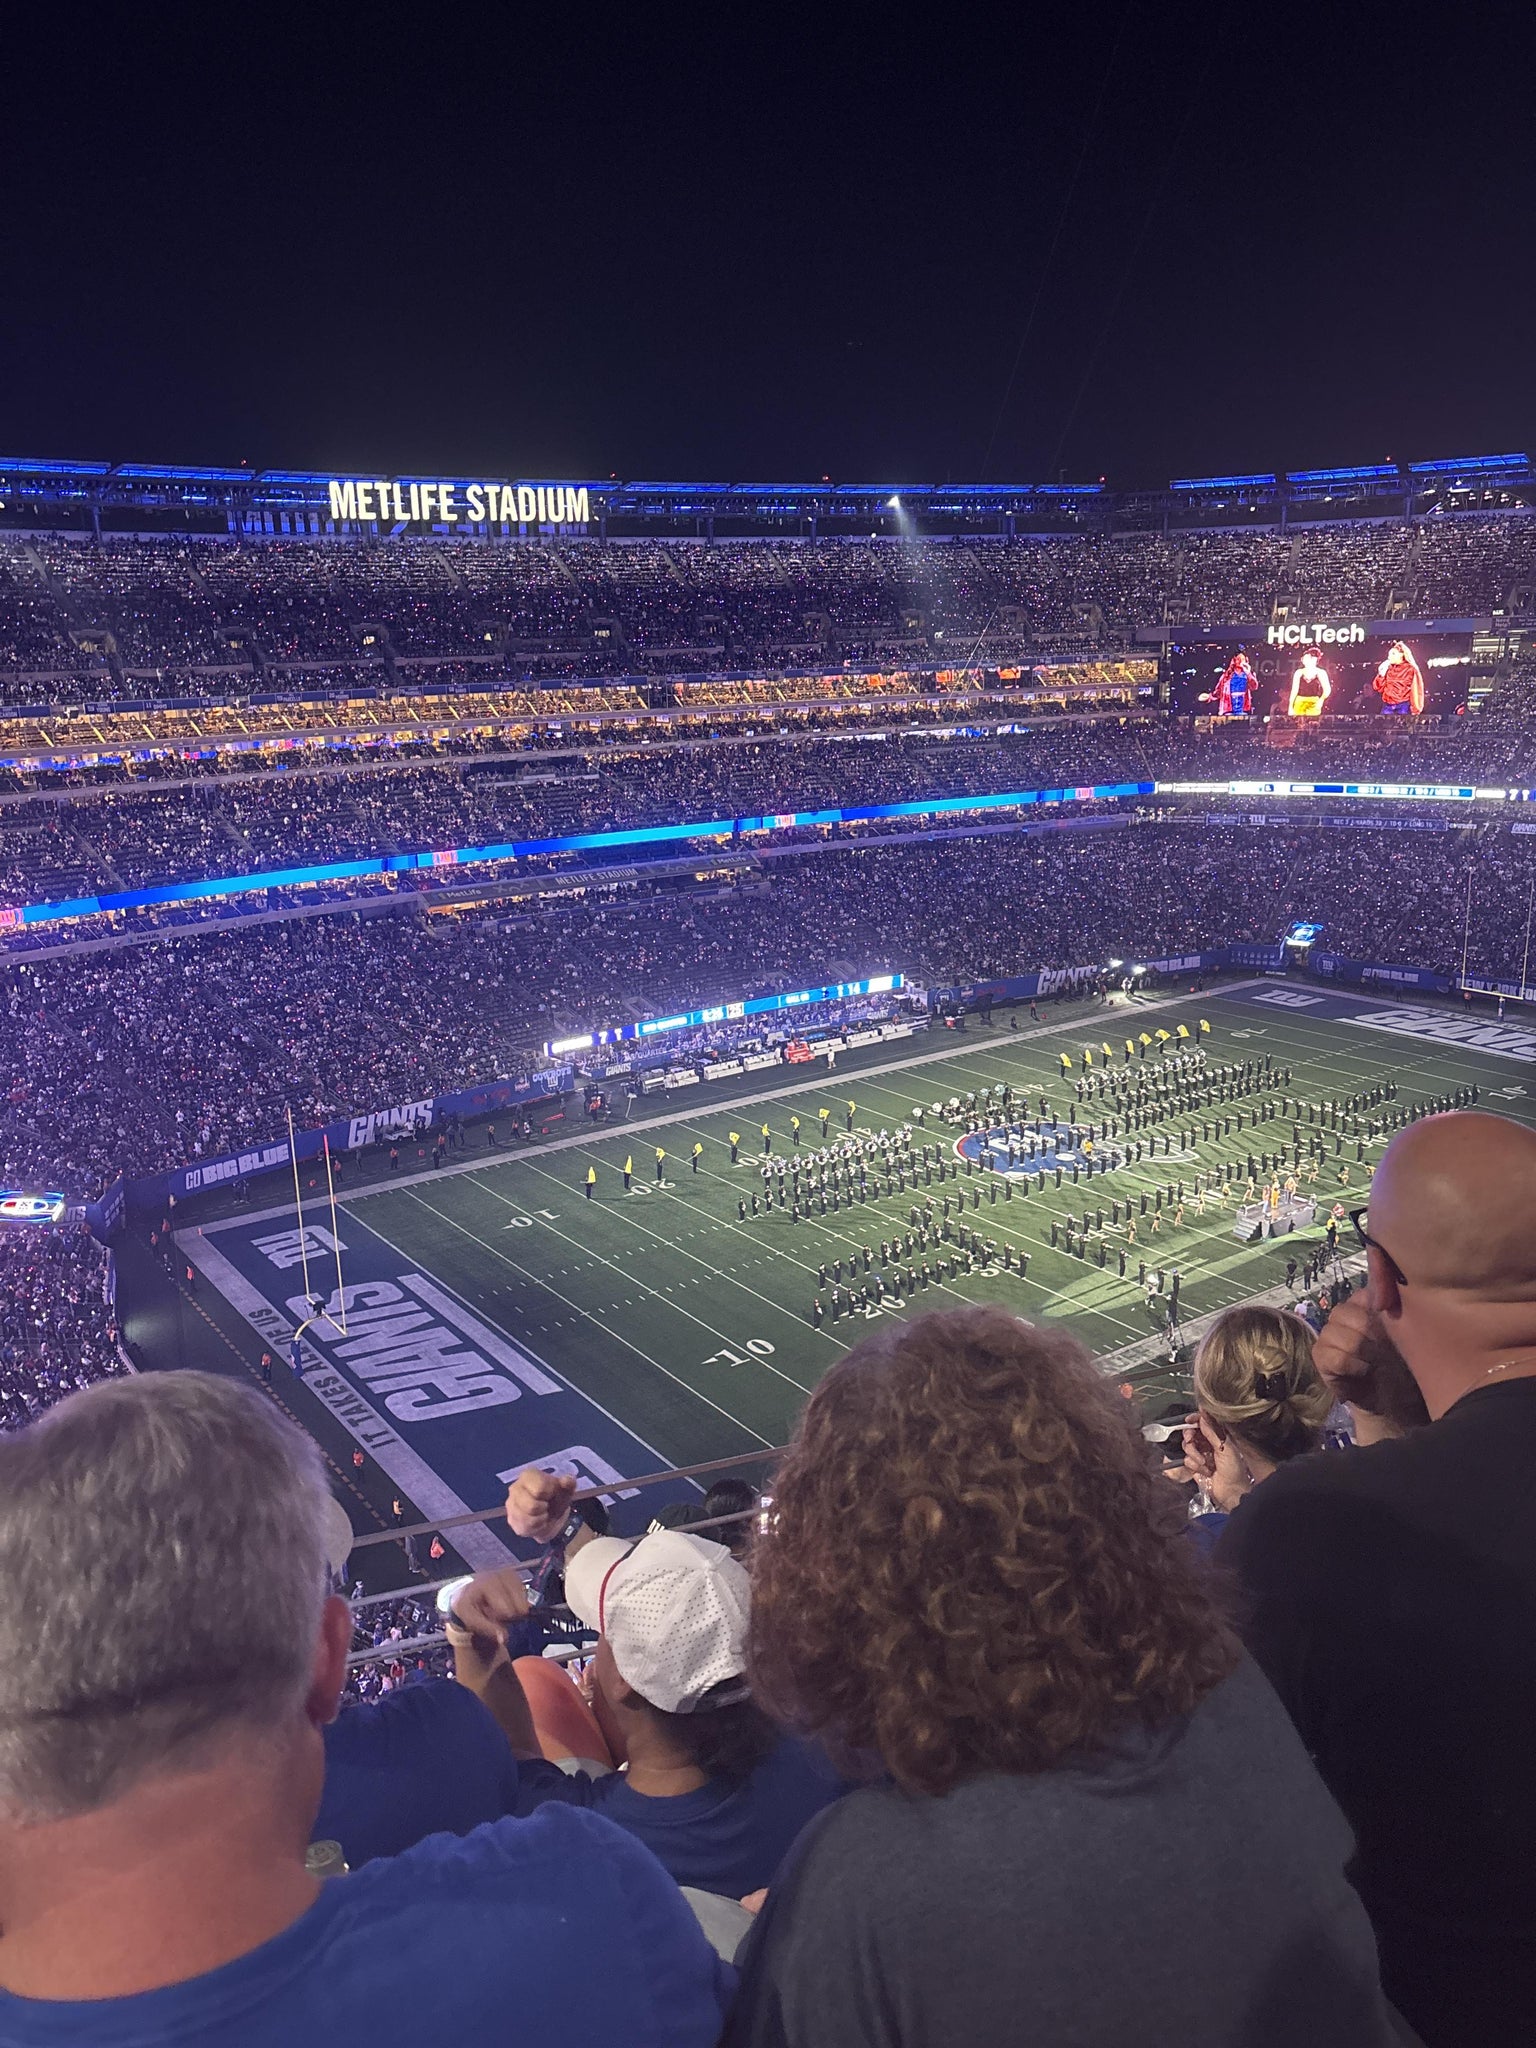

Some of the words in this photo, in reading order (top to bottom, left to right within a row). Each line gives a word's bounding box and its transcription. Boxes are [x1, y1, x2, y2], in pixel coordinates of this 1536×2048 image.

[328, 481, 458, 521] METLIFE
[466, 484, 589, 523] STADIUM
[1268, 624, 1365, 645] HCLTech
[605, 1062, 631, 1077] GIANTS
[349, 1099, 434, 1149] GIANTS
[186, 1171, 200, 1190] GO
[202, 1159, 239, 1185] BIG
[238, 1144, 289, 1174] BLUE
[631, 1177, 676, 1196] 20
[511, 1208, 561, 1229] 10
[249, 1308, 280, 1327] US
[285, 1281, 522, 1422] GIANTS
[716, 1339, 776, 1368] 10
[313, 1375, 375, 1428] TAKES
[361, 1430, 398, 1450] IT
